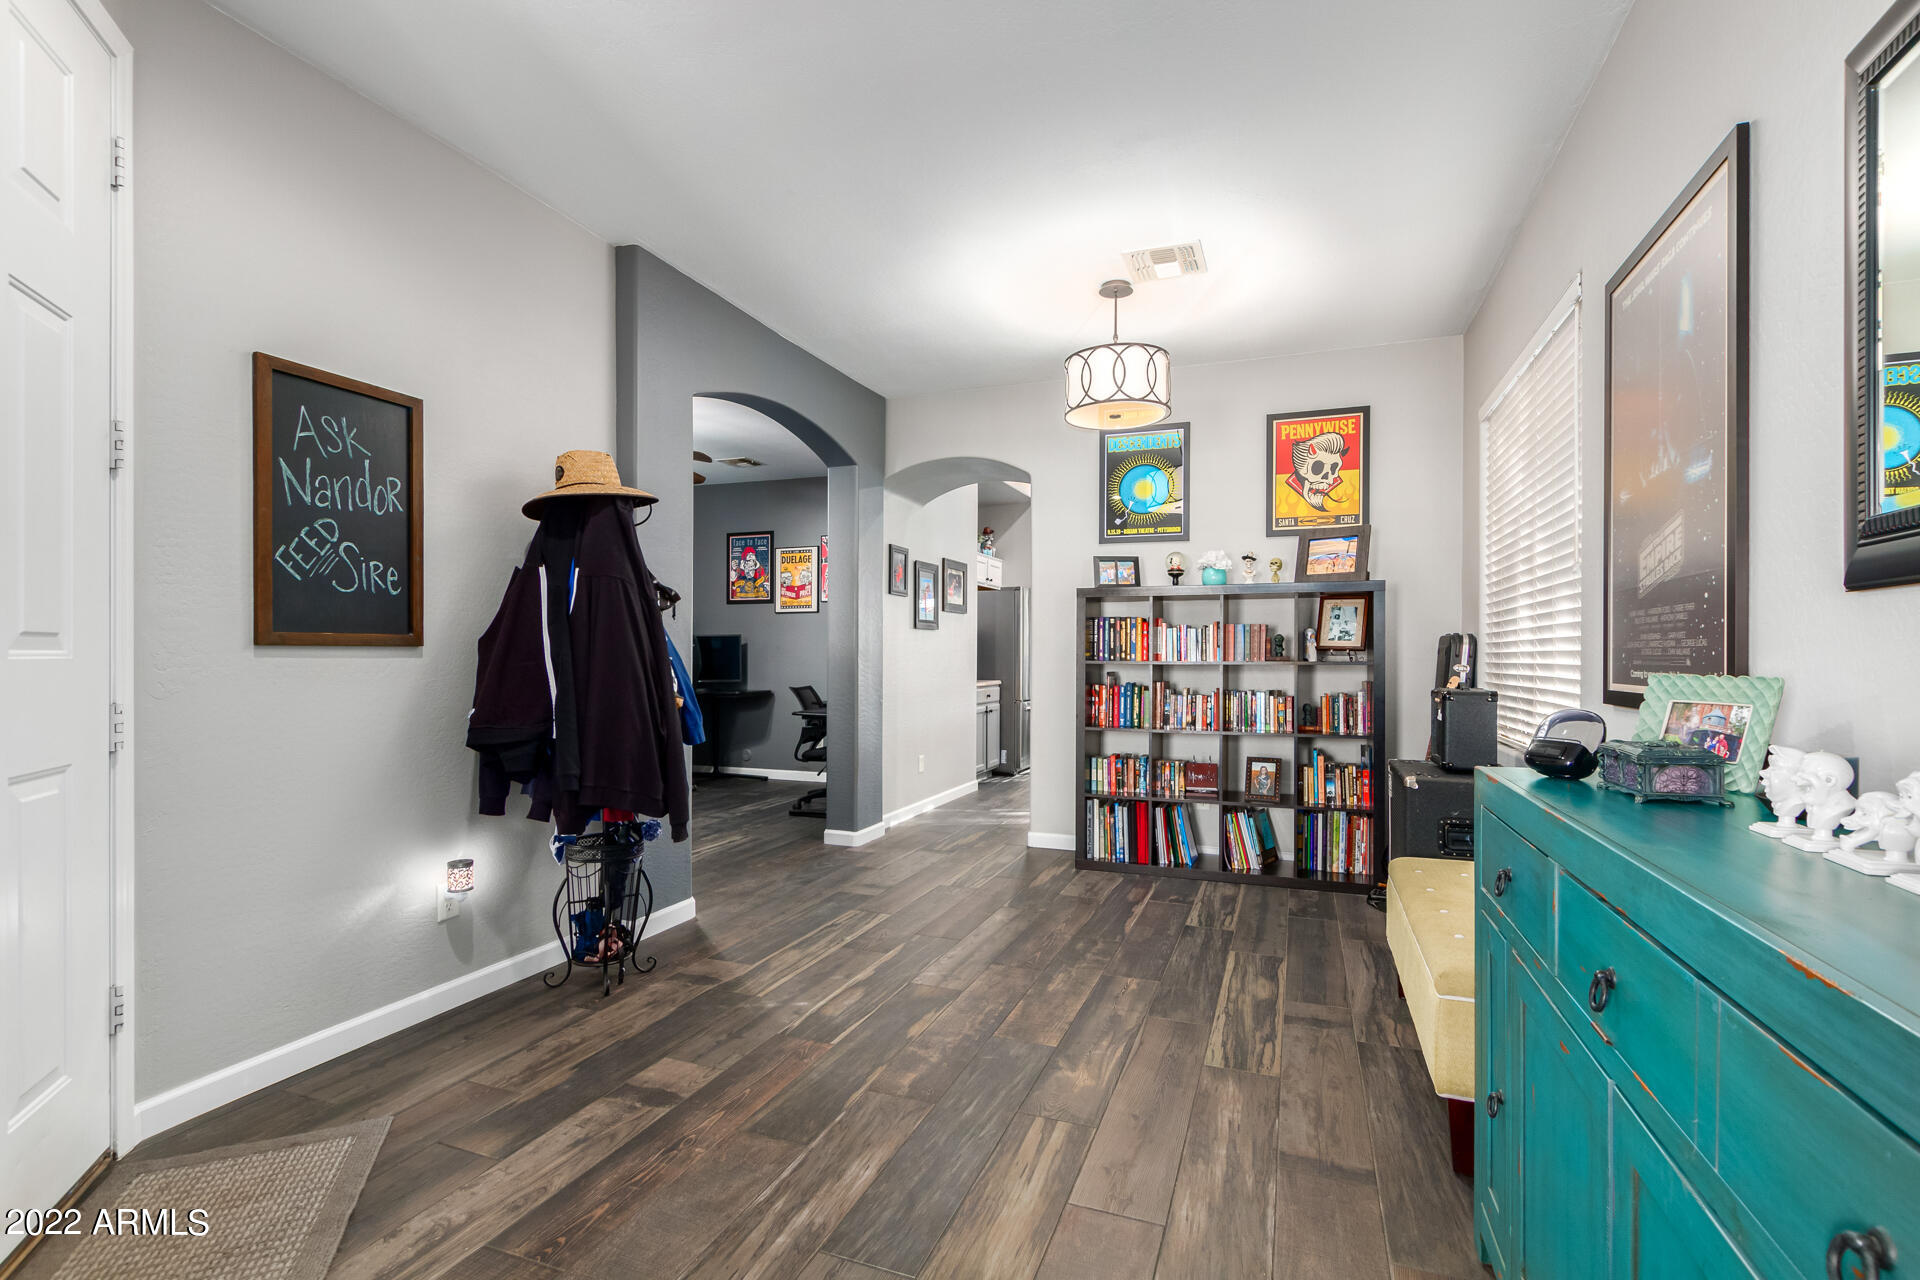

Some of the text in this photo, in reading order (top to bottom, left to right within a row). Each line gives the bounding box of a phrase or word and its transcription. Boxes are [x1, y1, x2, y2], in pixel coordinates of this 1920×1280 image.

[1281, 419, 1356, 440] PENNYWISE
[1108, 432, 1181, 453] DESCENDENTS
[1278, 515, 1357, 527] SANTA CRUZ
[274, 517, 339, 581] FEED
[733, 539, 745, 547] face
[754, 537, 767, 546] face
[781, 554, 812, 564] DUELAGE
